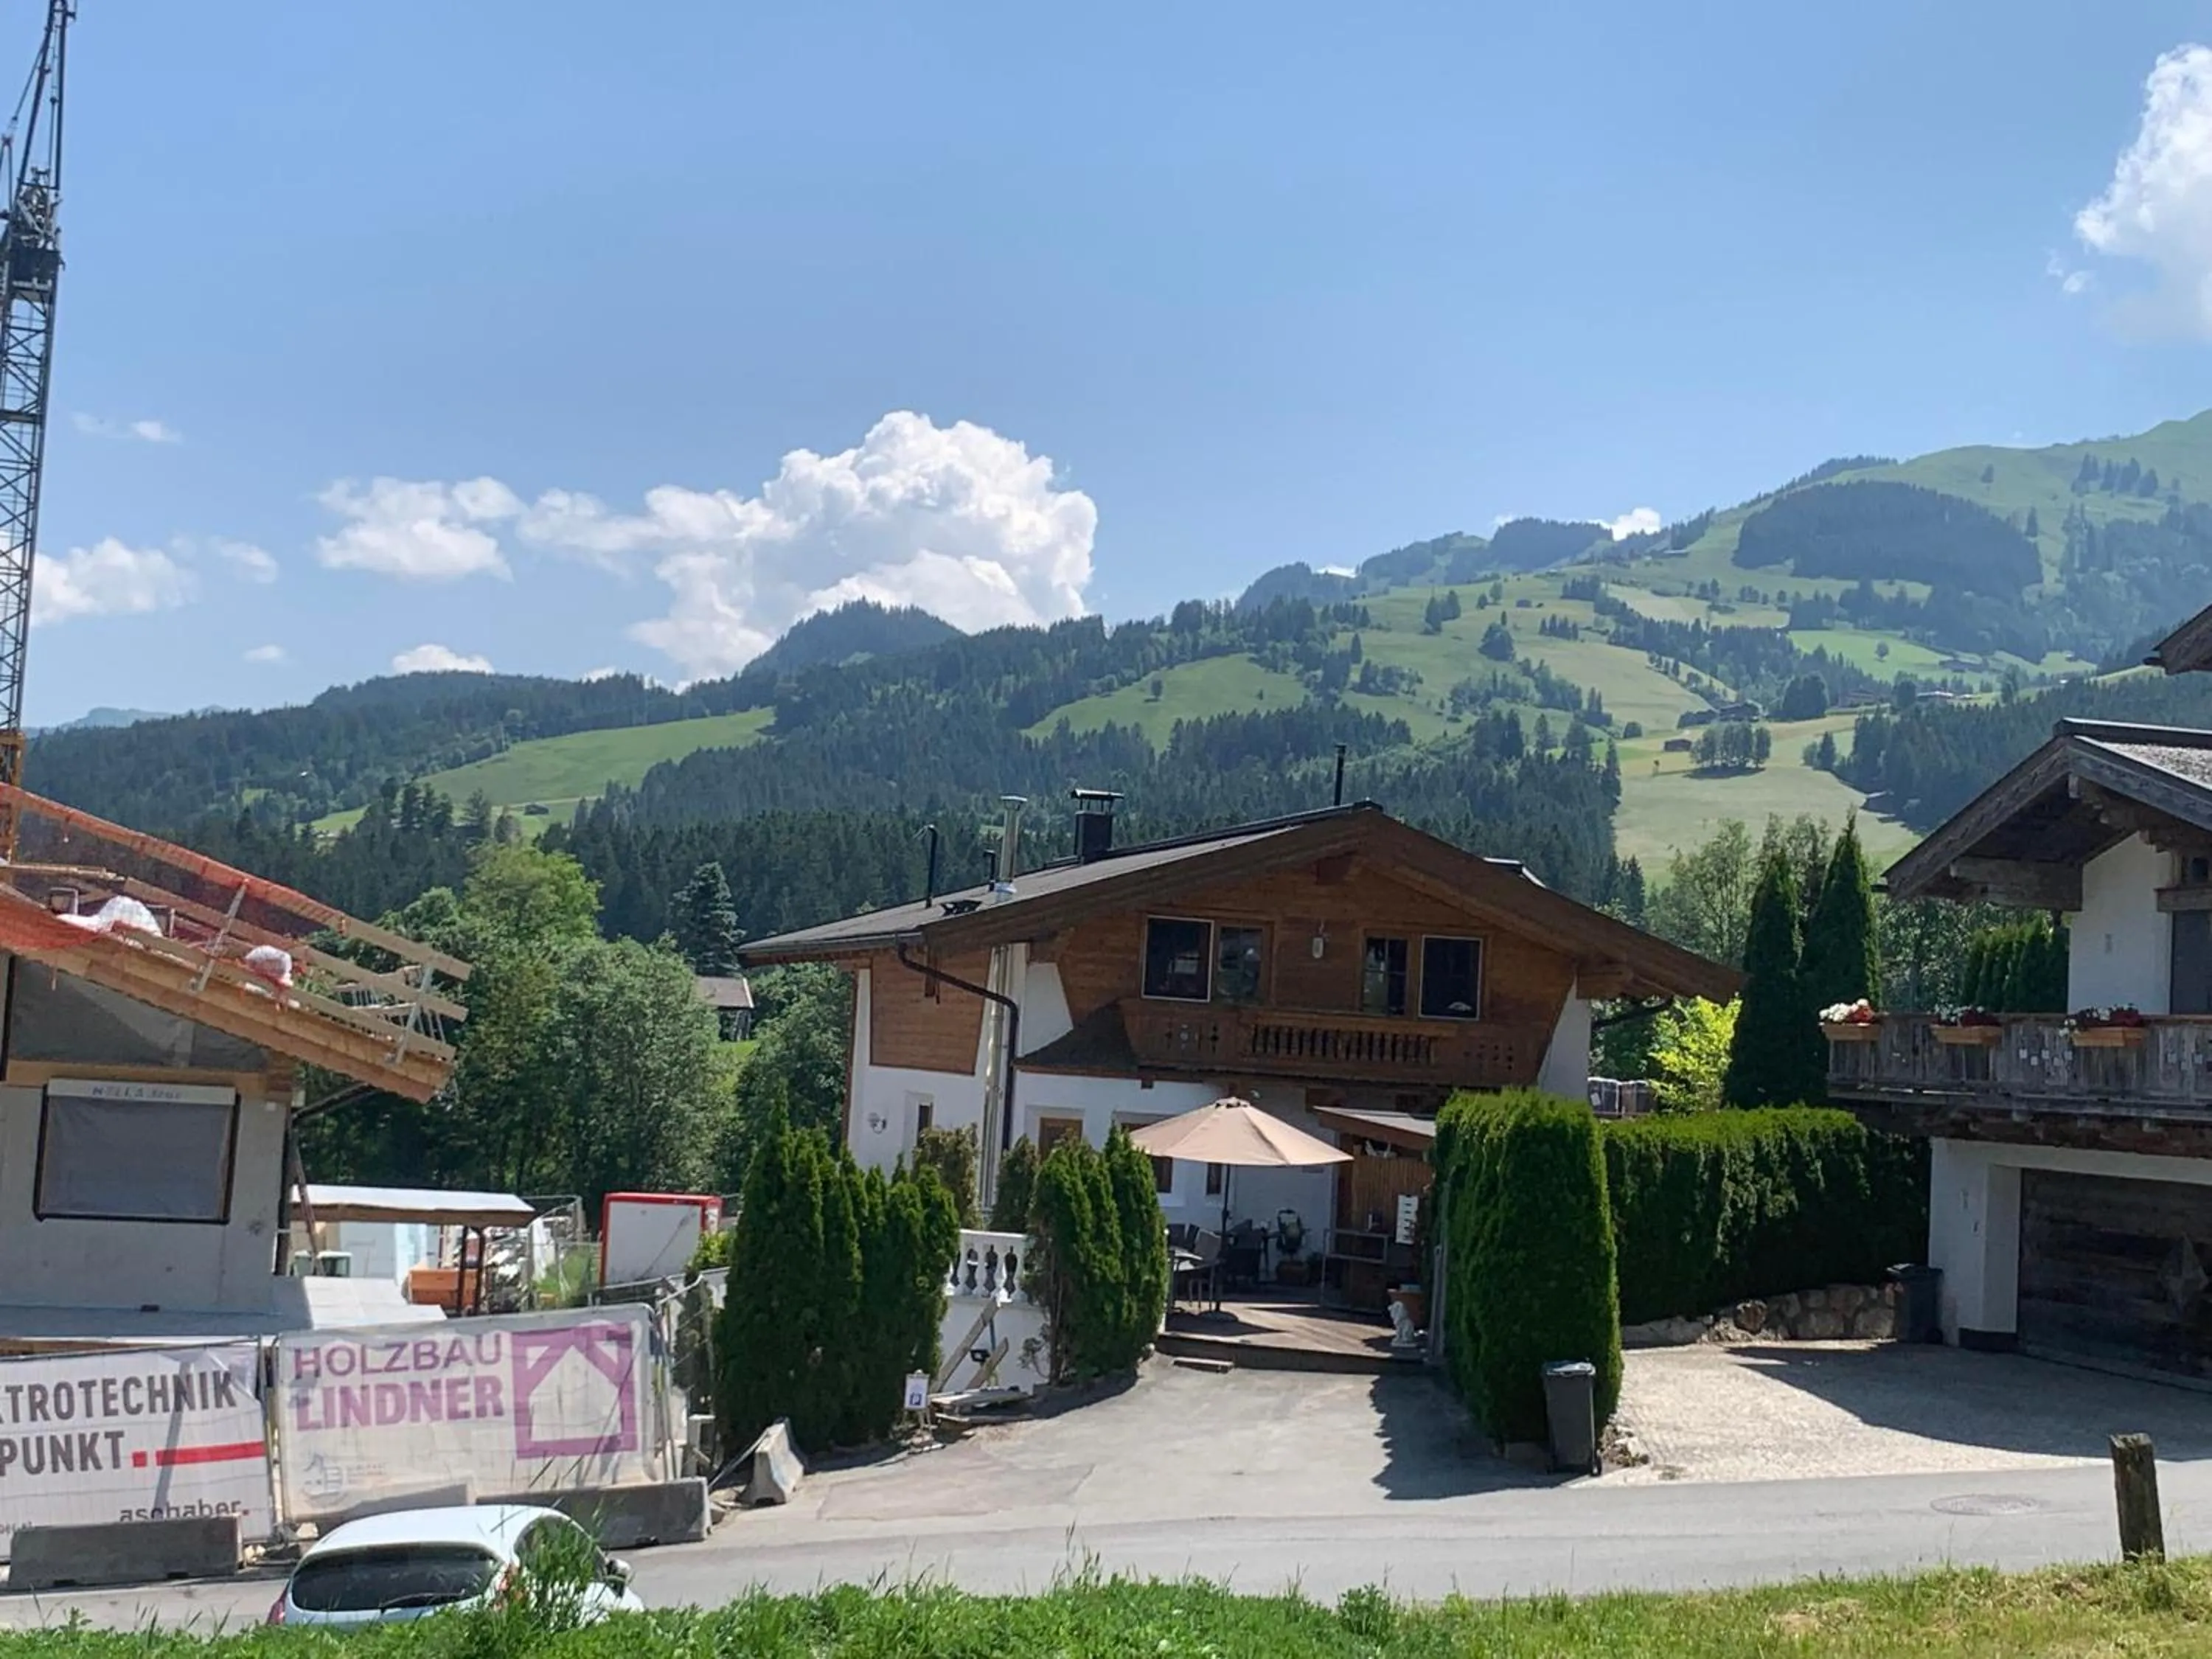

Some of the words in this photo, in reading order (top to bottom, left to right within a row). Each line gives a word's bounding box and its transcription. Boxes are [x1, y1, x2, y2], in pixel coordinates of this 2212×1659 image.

[294, 1332, 502, 1380] HOLZBAU
[0, 1369, 237, 1424] TROTECHNIK
[296, 1374, 505, 1432] LINDNER
